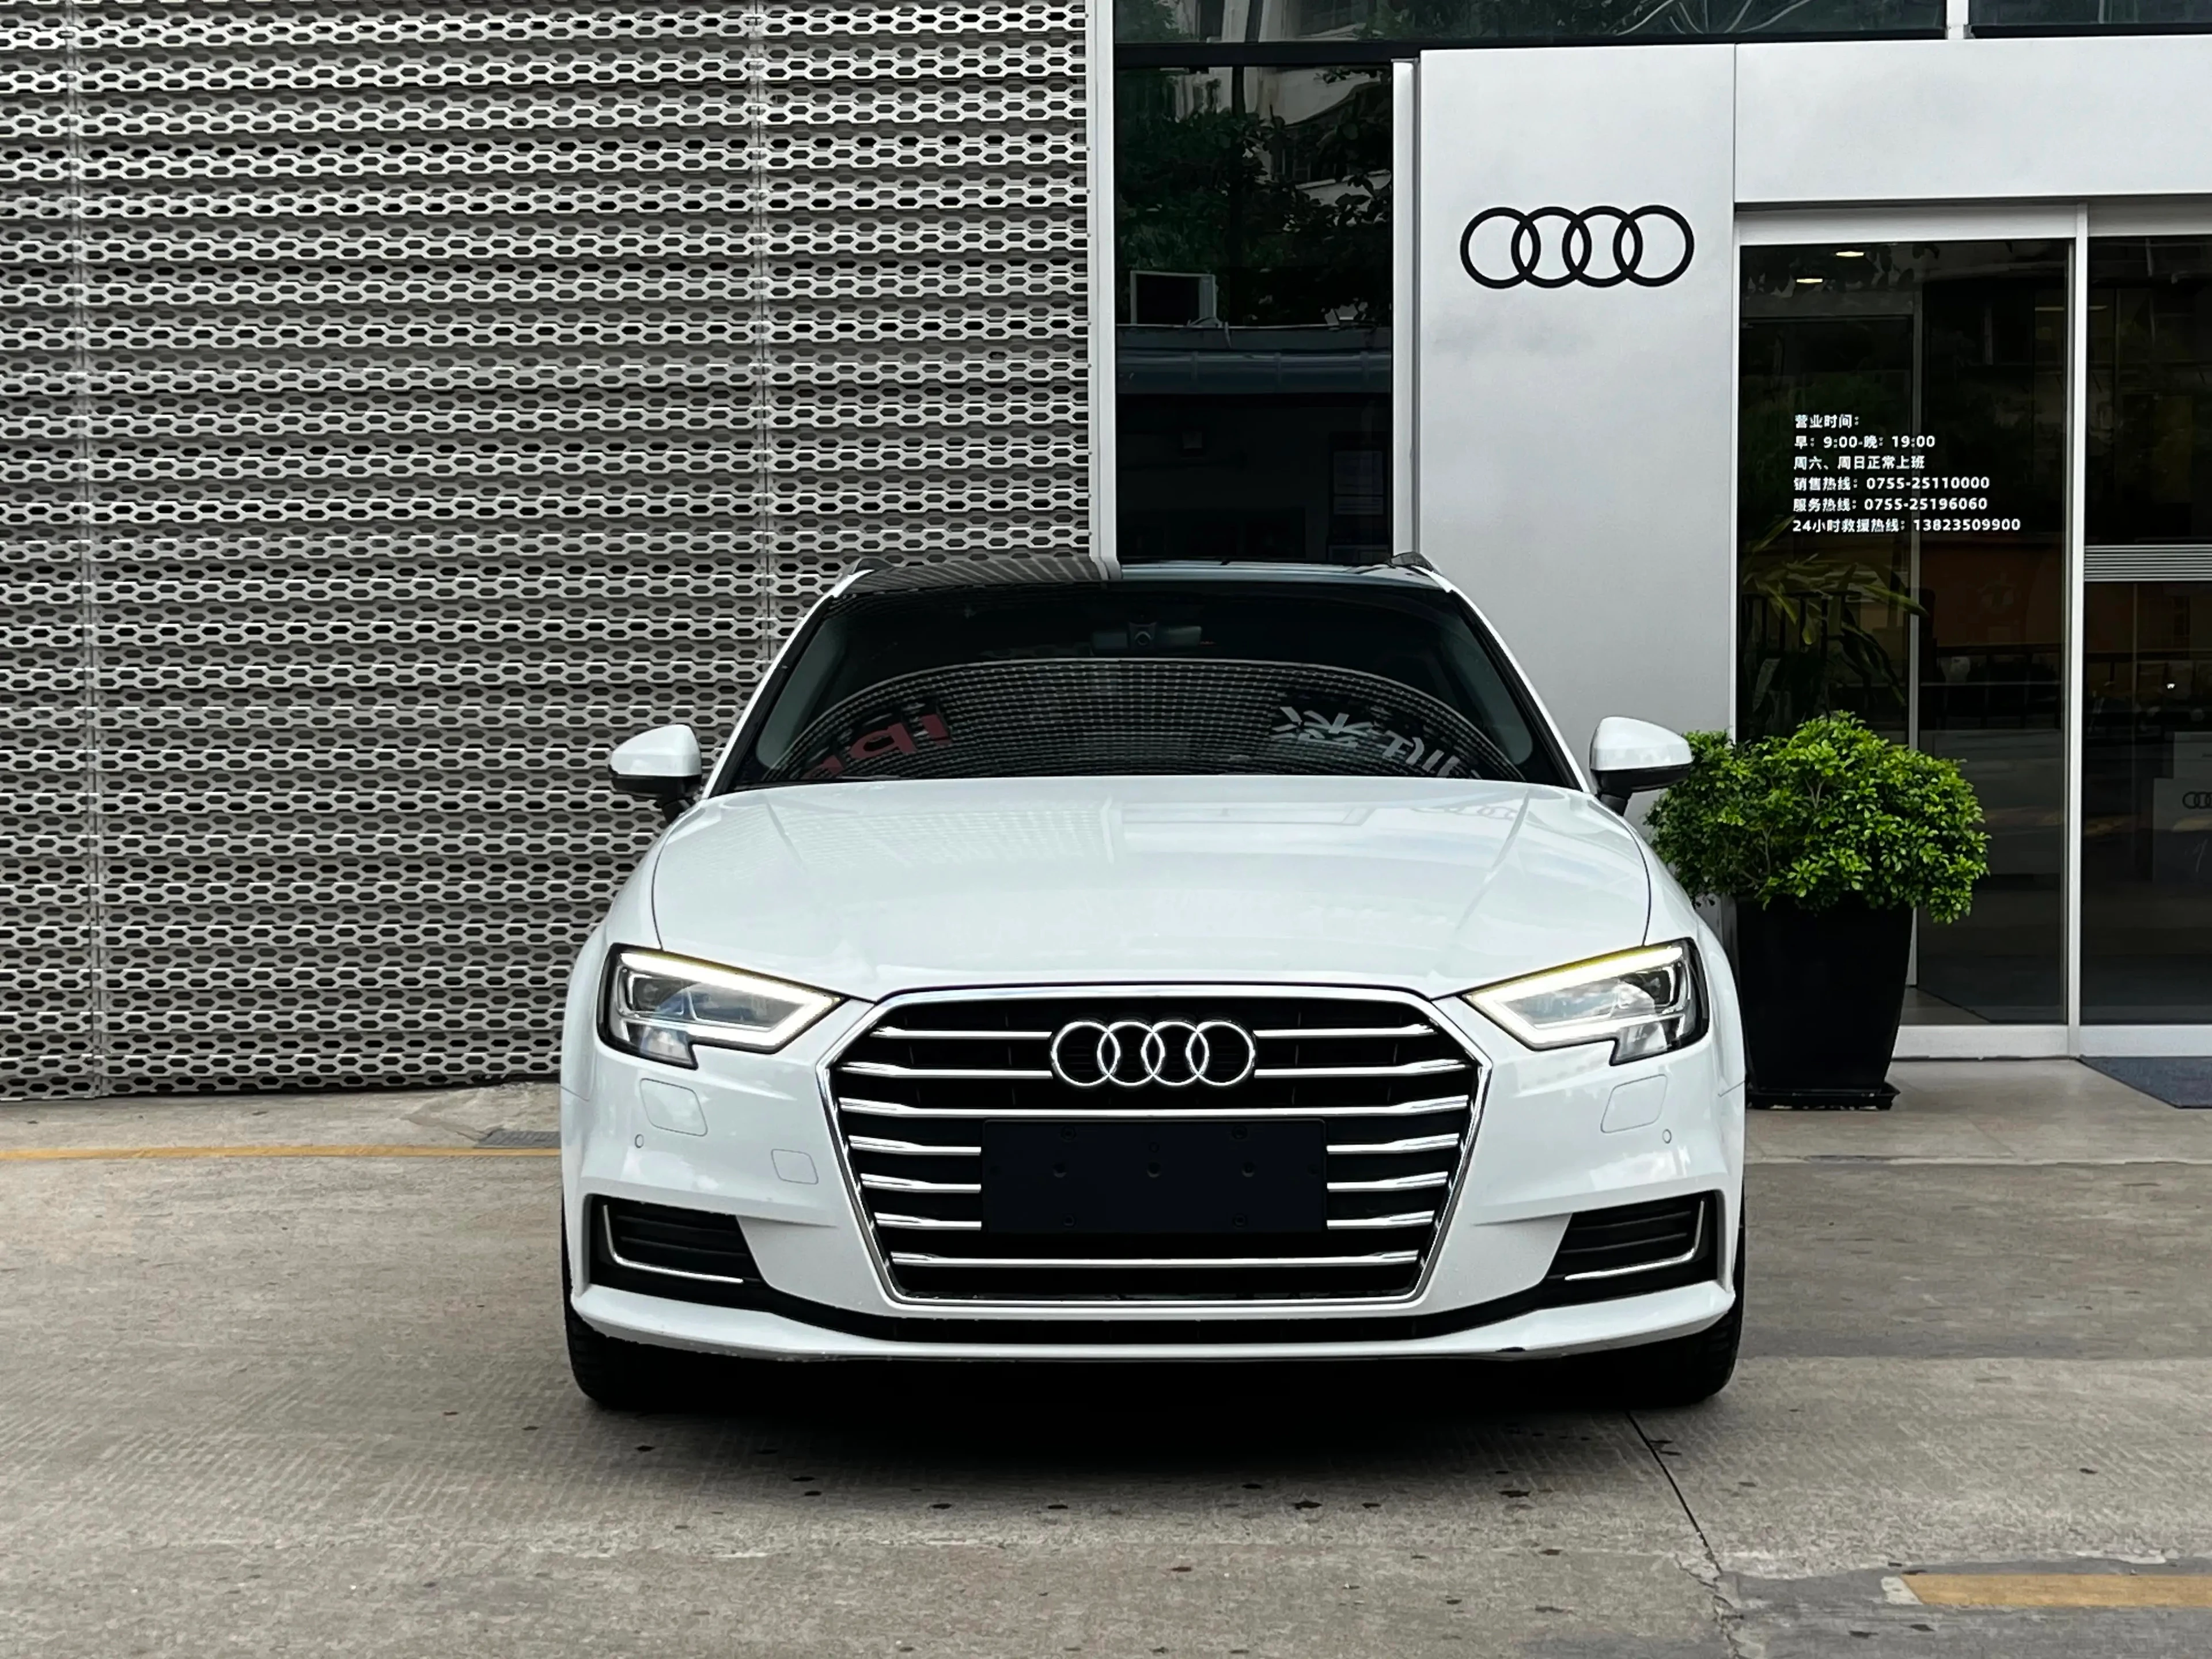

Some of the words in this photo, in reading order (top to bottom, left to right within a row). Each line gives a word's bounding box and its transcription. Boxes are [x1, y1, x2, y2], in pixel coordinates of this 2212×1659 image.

[1794, 455, 1925, 470] 周六、周日正常上班
